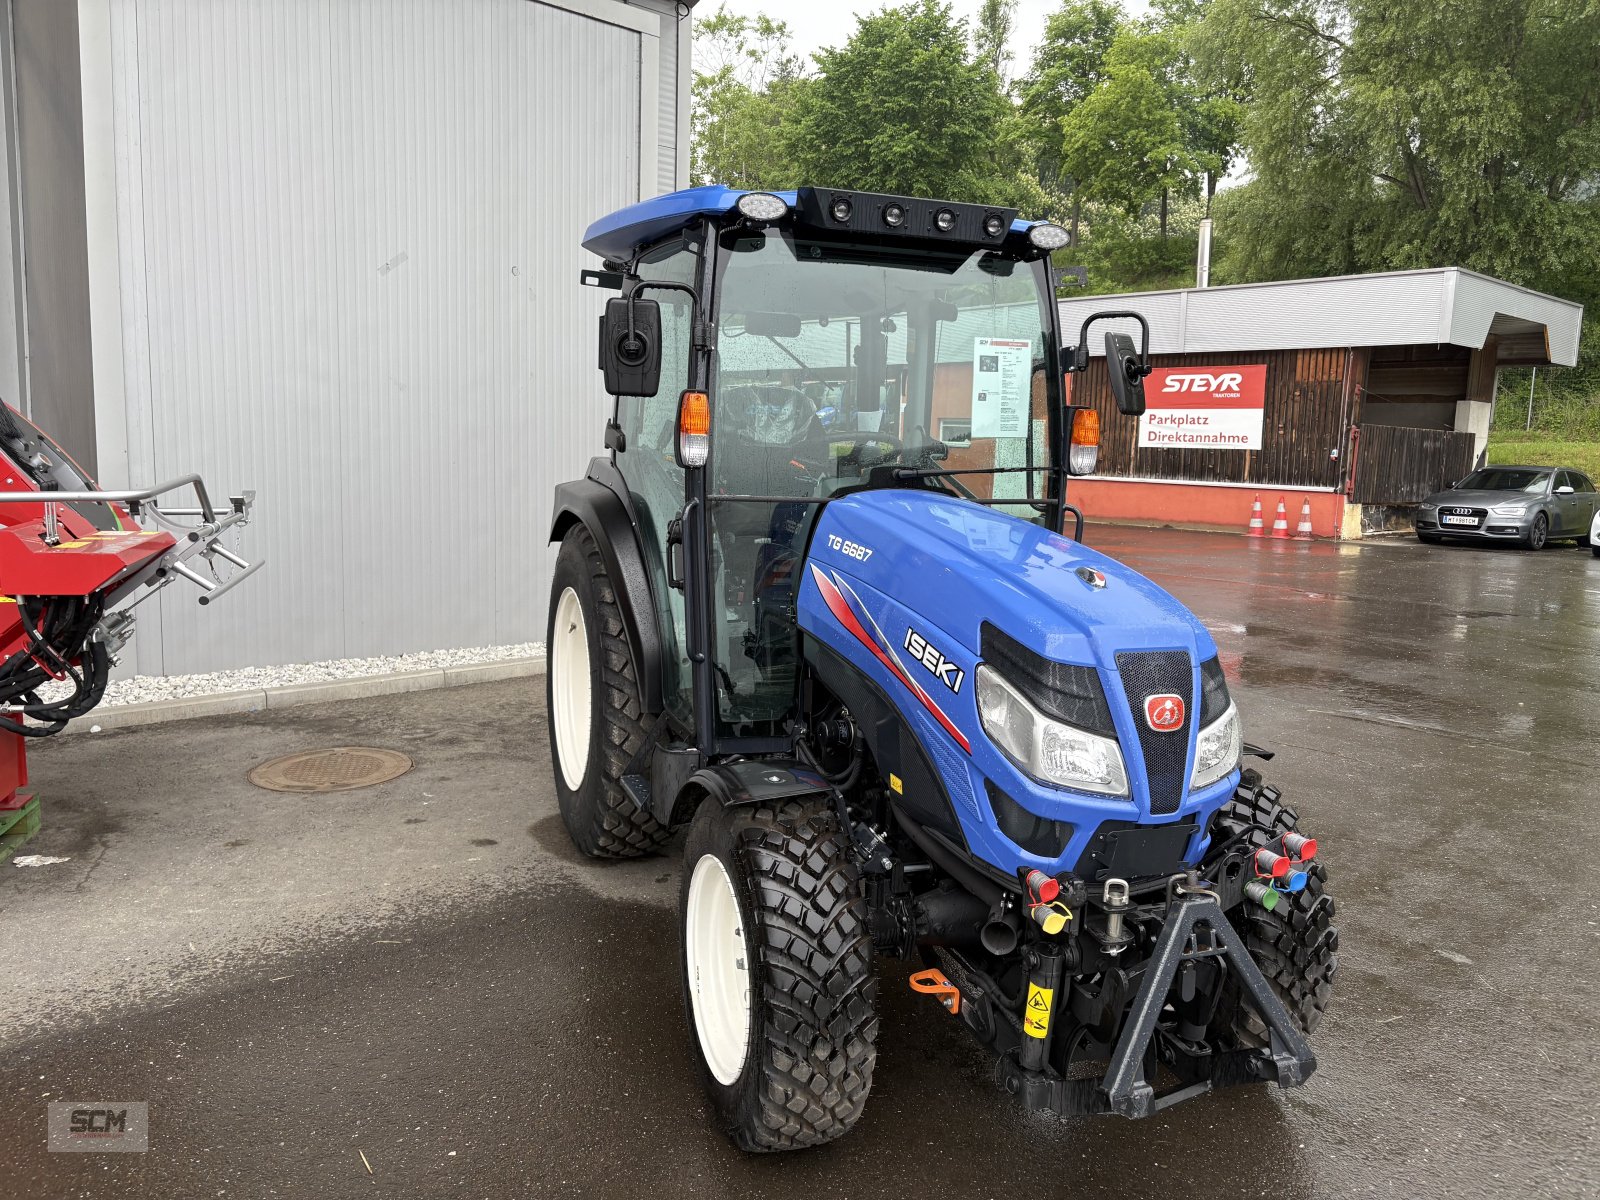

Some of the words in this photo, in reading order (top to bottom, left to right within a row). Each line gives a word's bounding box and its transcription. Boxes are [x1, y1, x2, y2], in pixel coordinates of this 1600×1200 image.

[1161, 373, 1242, 392] STEYR
[1148, 414, 1209, 428] Parkplatz
[1147, 431, 1249, 444] Direktannahme
[828, 534, 842, 550] TG
[842, 540, 873, 562] 6687
[903, 626, 966, 695] ISEKI
